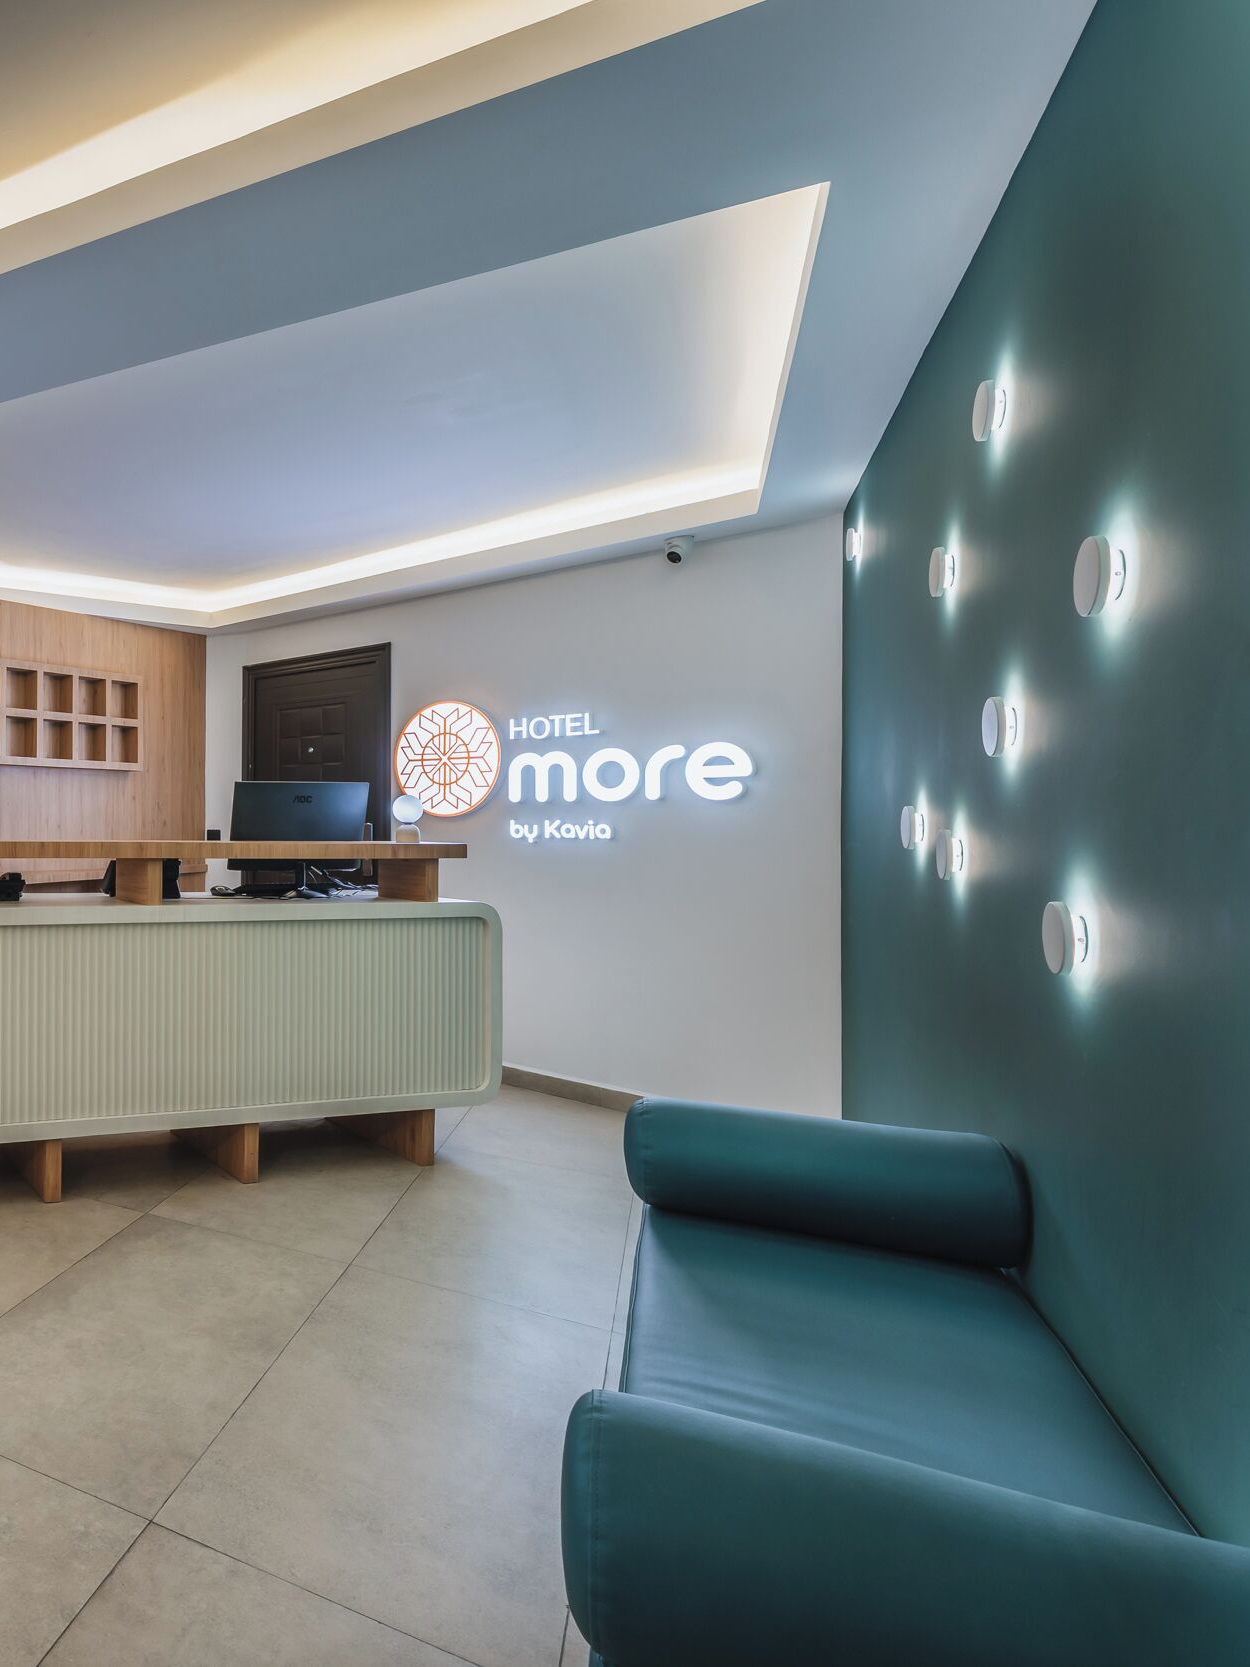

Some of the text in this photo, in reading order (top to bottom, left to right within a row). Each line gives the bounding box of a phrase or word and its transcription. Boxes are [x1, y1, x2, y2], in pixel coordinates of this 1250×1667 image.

[509, 712, 600, 740] HOTEL
[508, 741, 754, 803] more
[292, 795, 313, 804] AOC
[509, 819, 612, 843] by Kavia
